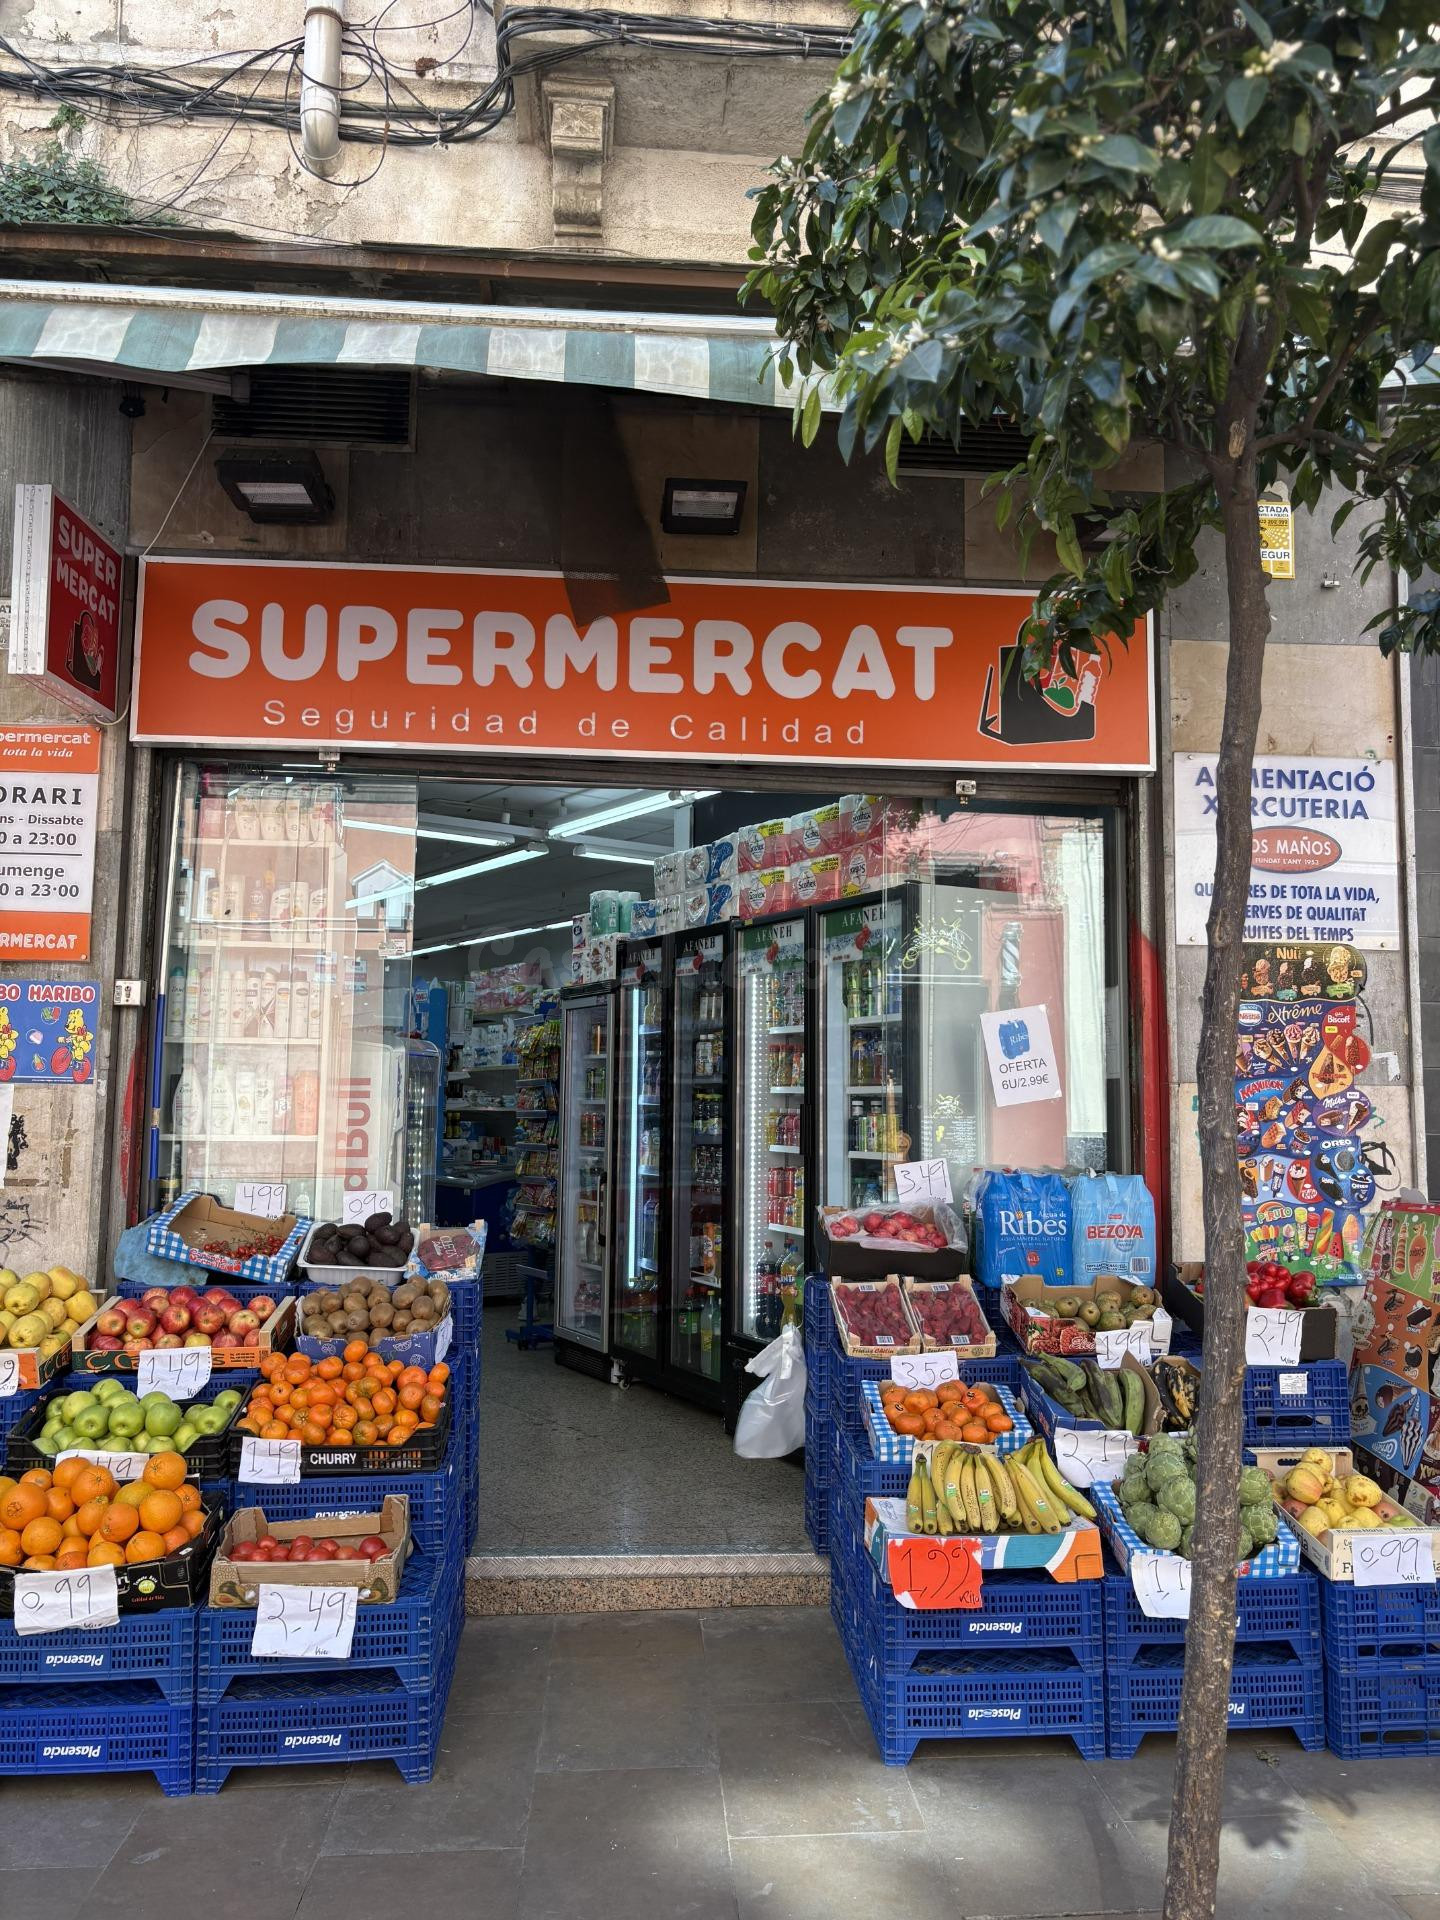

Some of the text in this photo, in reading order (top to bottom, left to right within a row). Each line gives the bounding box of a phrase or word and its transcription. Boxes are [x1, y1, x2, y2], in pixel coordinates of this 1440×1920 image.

[1258, 506, 1289, 514] CTADA
[58, 514, 117, 590] SUPER
[1261, 551, 1290, 560] EGUR
[56, 556, 116, 625] MERCAT
[189, 599, 954, 701] SUPERMERCAT
[263, 699, 865, 746] Seguridad de Calidad
[3, 747, 73, 758] tota la vida
[1195, 766, 1376, 792] AENTACIÓ
[1203, 795, 1369, 820] XRCUTERIA
[28, 814, 84, 826] Dissabte
[13, 835, 22, 845] a
[28, 832, 77, 846] 23:00
[1252, 836, 1332, 856] OS MAÑOS
[15, 886, 24, 896] a
[1270, 885, 1287, 899] DE
[1291, 885, 1323, 900] TOTA
[1326, 887, 1341, 901] LA
[1344, 887, 1380, 903] VIDA,
[1245, 905, 1282, 920] ERVES
[1286, 906, 1303, 920] DE
[0, 933, 78, 949] RMERCAT
[755, 925, 792, 943] AFANEH
[1242, 926, 1355, 942] RUITES DEL TEMPS
[28, 985, 95, 1003] HARIBO
[999, 1058, 1048, 1074] OFERTA
[1321, 1139, 1352, 1149] OREO
[999, 1210, 1067, 1236] Ribes
[1087, 1224, 1144, 1239] BEZOYA
[147, 1352, 200, 1391] 1,49
[247, 1441, 300, 1477] 1,49
[309, 1452, 357, 1465] CHURRY
[1361, 1537, 1420, 1575] 0,99
[901, 1547, 970, 1600] 1,99
[22, 1574, 91, 1619] 0,99
[969, 1622, 1023, 1634] Plasencia
[46, 1654, 104, 1667] Plasencia
[968, 1708, 1022, 1721] Plasecia
[284, 1734, 342, 1748] Plasencia
[43, 1745, 101, 1759] Plasencia
